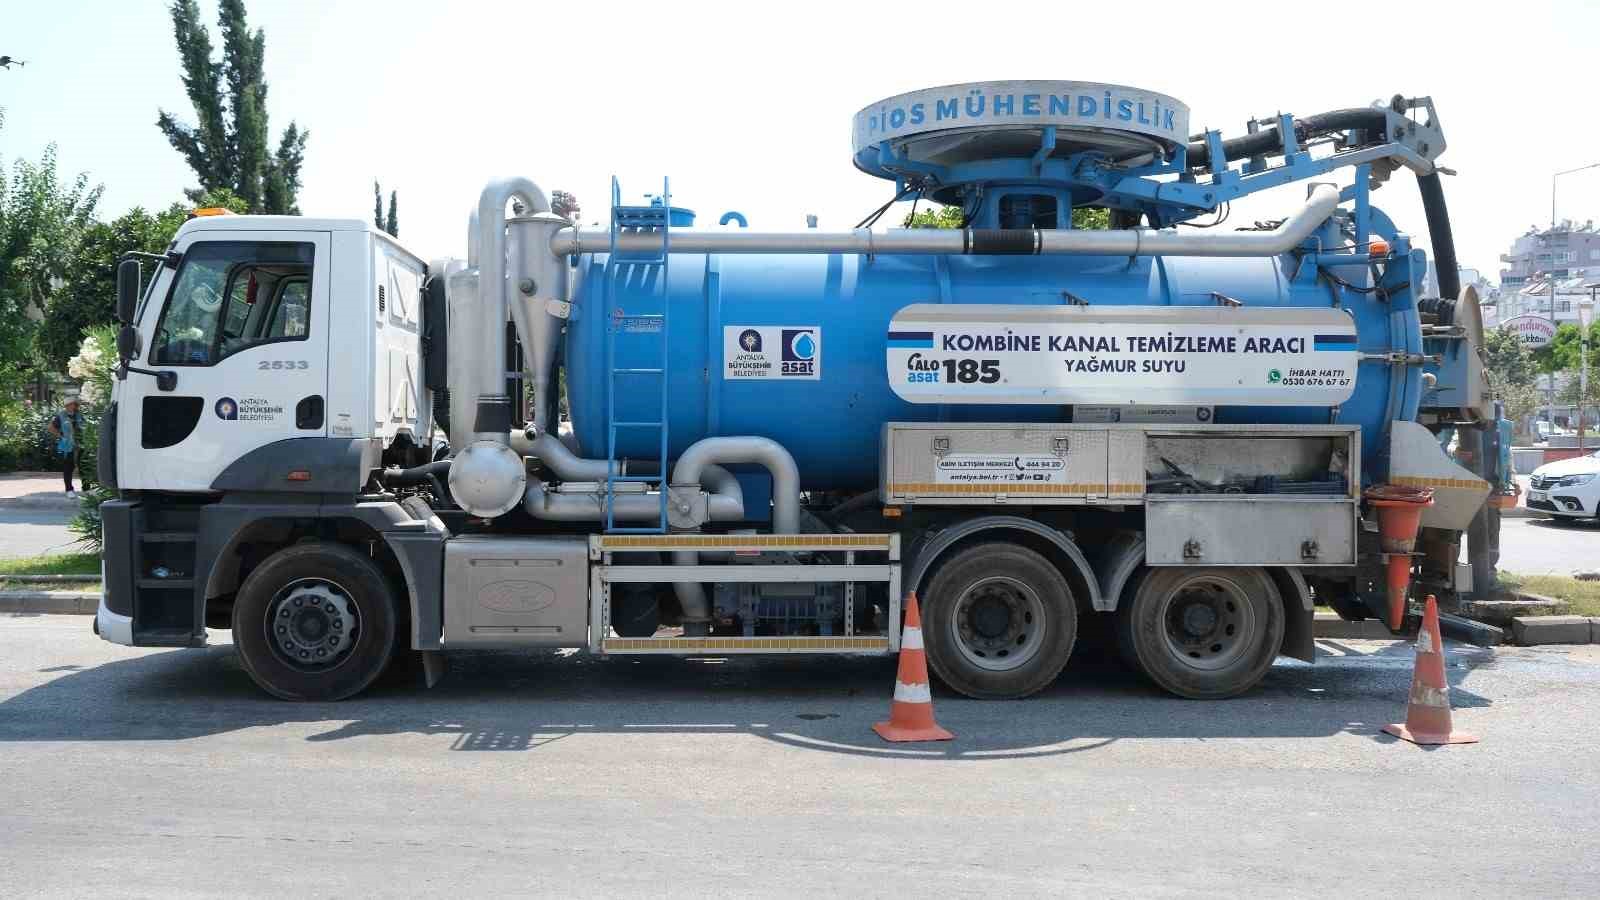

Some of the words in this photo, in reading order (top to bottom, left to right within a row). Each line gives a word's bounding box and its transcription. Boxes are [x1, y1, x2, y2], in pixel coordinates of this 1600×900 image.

[869, 103, 925, 136] PİOS
[936, 89, 1175, 131] MÜHENDİSLİK
[943, 331, 1040, 351] KOMBİNE
[1048, 336, 1120, 352] KANAL
[1127, 332, 1236, 353] TEMİZLEME
[1243, 337, 1305, 354] ARACI
[258, 361, 309, 370] 2533
[781, 361, 814, 372] asat
[1064, 356, 1136, 372] YAĞMUR
[1142, 360, 1186, 372] SUYU
[912, 358, 940, 371] ALO
[942, 359, 1000, 383] 185
[1289, 368, 1317, 377] İHBAR
[907, 372, 939, 382] asat
[1282, 378, 1305, 386] 0530
[1306, 378, 1324, 386] 676
[1326, 378, 1337, 386] 67
[1339, 378, 1351, 386] 67
